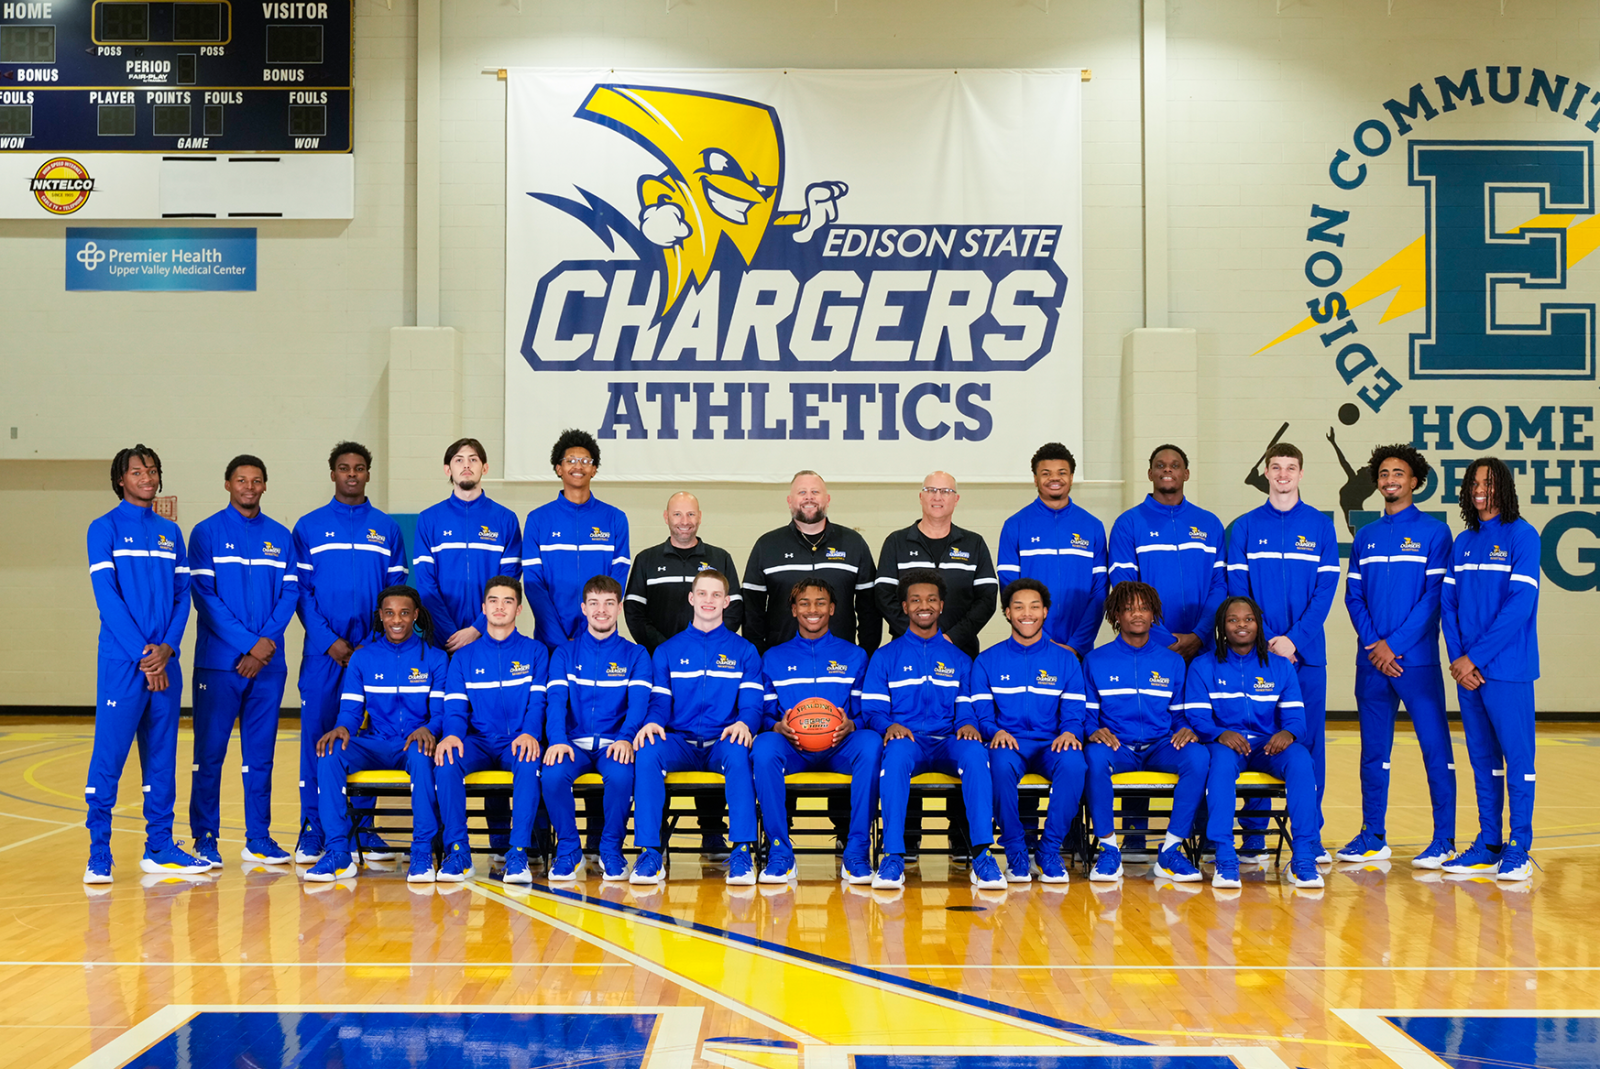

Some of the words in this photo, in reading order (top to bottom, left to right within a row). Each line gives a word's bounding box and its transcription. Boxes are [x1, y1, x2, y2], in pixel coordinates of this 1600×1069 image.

[3, 3, 52, 19] HOME
[262, 2, 328, 19] VISITOR
[97, 46, 122, 56] POSS
[200, 46, 225, 56] POSS
[126, 60, 171, 73] PERIOD
[17, 69, 59, 82] BONUS
[263, 69, 305, 82] BONUS
[89, 91, 135, 104] PLAYER
[146, 91, 191, 104] POINTS
[204, 91, 243, 104] FOULS
[289, 91, 328, 104] FOULS
[0, 137, 26, 149] WON
[177, 137, 209, 149] GAME
[294, 137, 320, 149] WON
[32, 179, 93, 191] NKTELCO
[821, 227, 951, 259] EDISON
[959, 227, 1057, 259] STATE
[109, 248, 168, 263] Premier
[171, 248, 222, 263] Health
[1408, 139, 1596, 380] E
[109, 265, 139, 277] Upper
[141, 265, 171, 277] Valley
[172, 265, 211, 275] Medical
[213, 265, 246, 275] Center
[1304, 203, 1403, 414] EDISON
[530, 268, 1059, 363] CHARGERS
[596, 381, 994, 442] ATHLETICS
[1409, 405, 1594, 451] HOME
